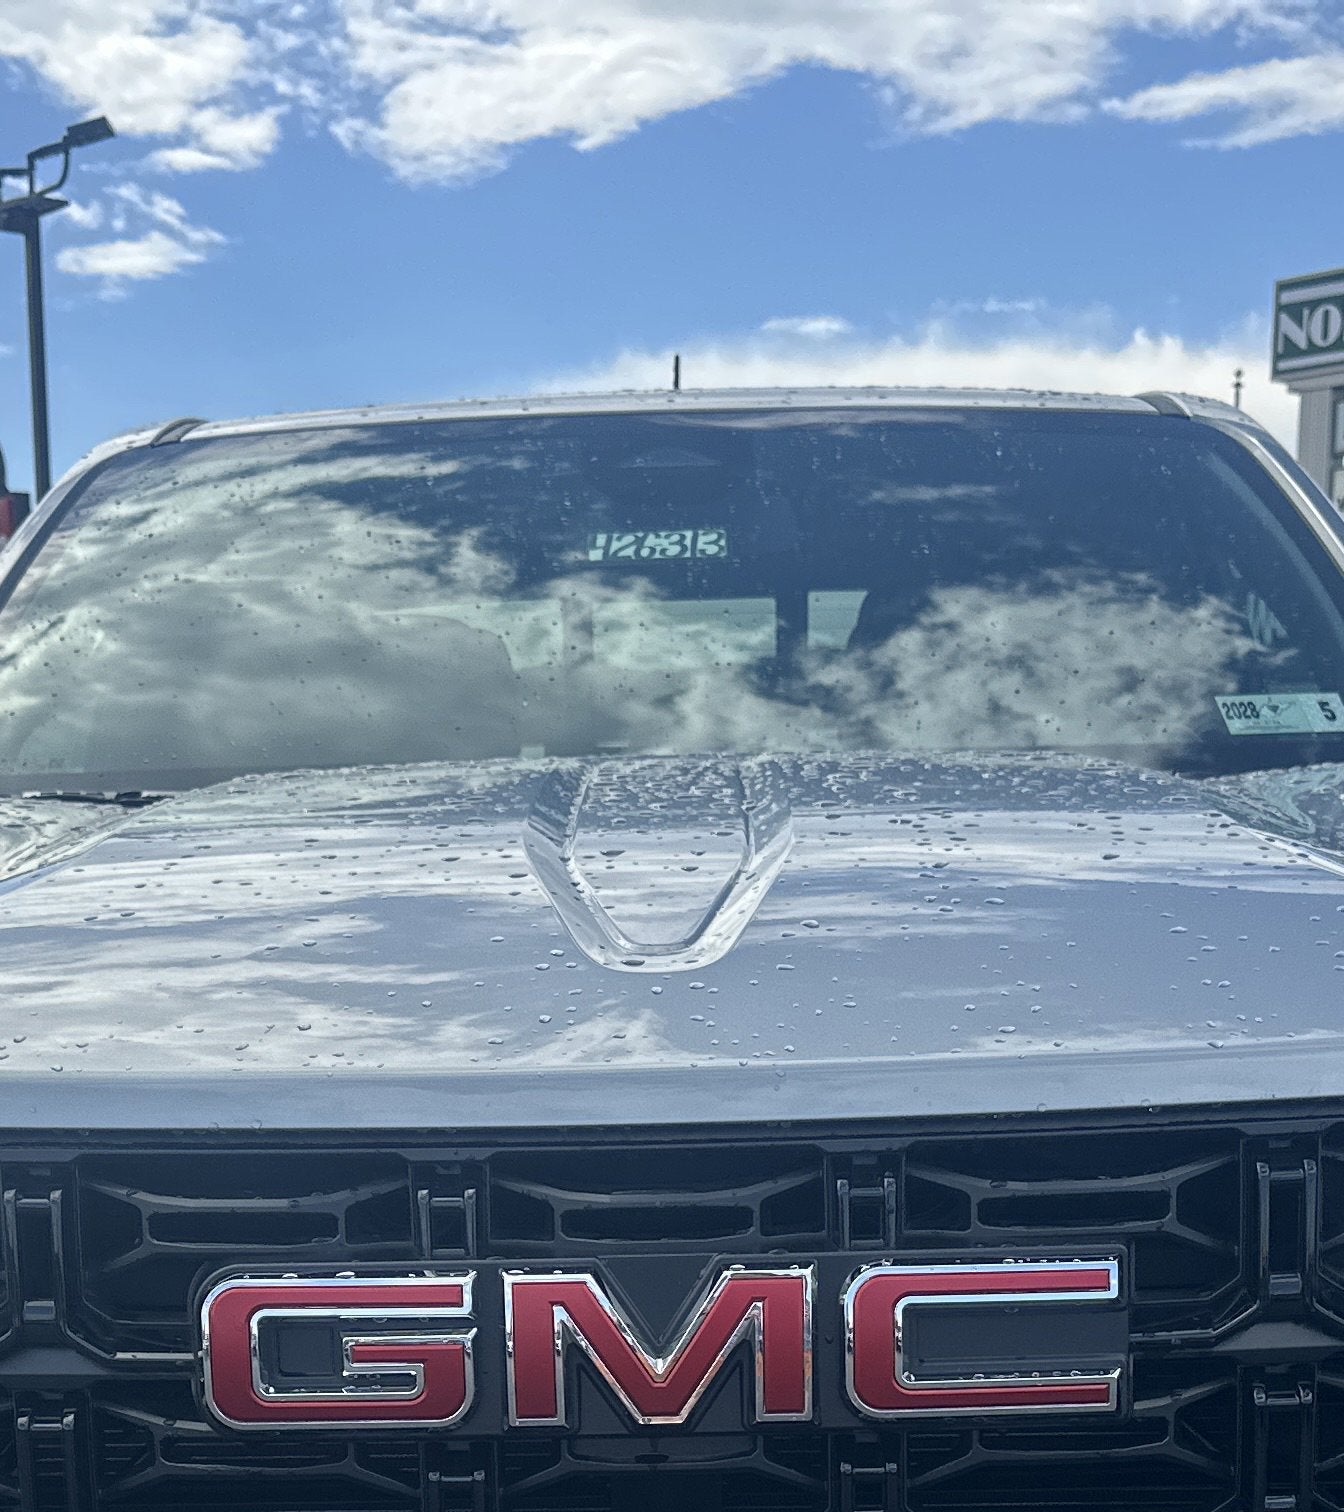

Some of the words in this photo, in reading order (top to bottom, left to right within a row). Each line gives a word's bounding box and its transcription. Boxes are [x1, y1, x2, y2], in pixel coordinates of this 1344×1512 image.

[1221, 701, 1260, 720] 2028
[1317, 701, 1337, 722] 5
[201, 1257, 1123, 1430] GMC
